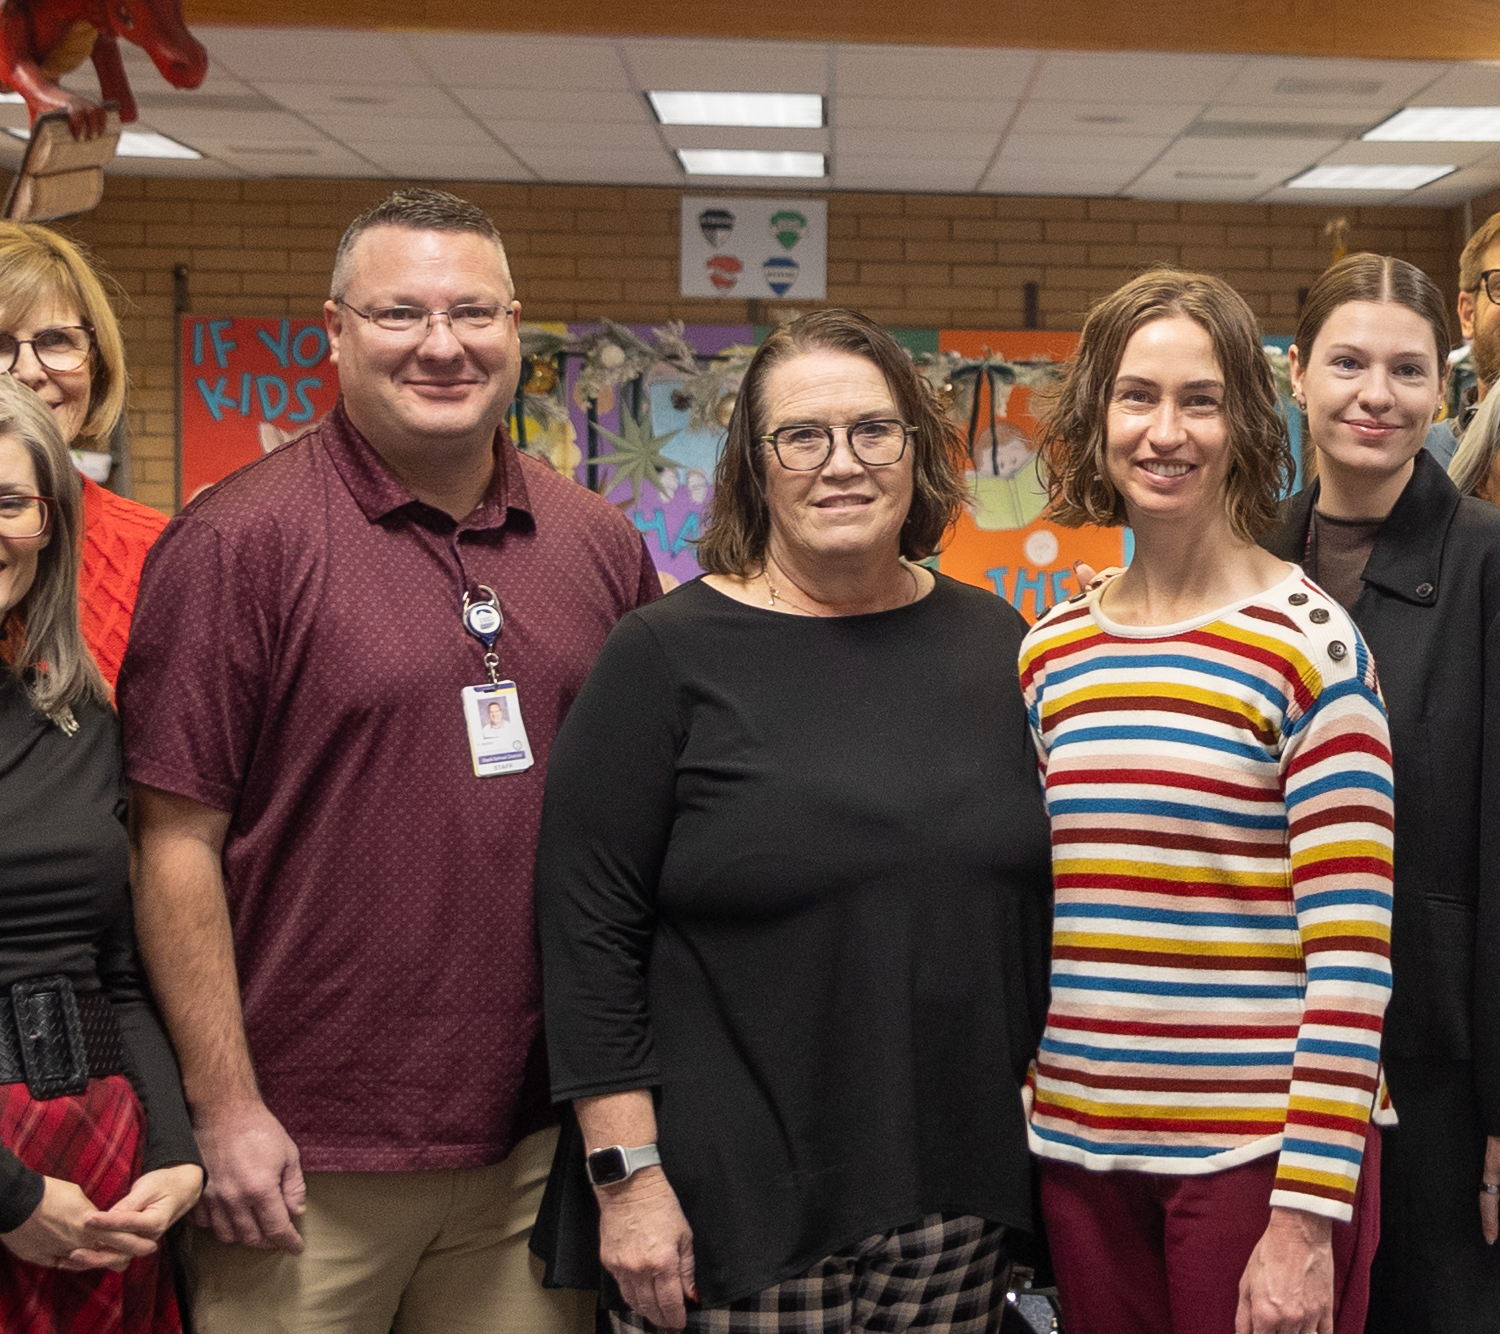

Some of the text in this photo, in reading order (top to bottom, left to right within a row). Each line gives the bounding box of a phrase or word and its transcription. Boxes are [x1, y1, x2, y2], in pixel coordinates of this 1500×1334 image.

[192, 317, 329, 368] IF YO
[195, 371, 323, 422] KIDS
[986, 565, 1072, 617] THE
